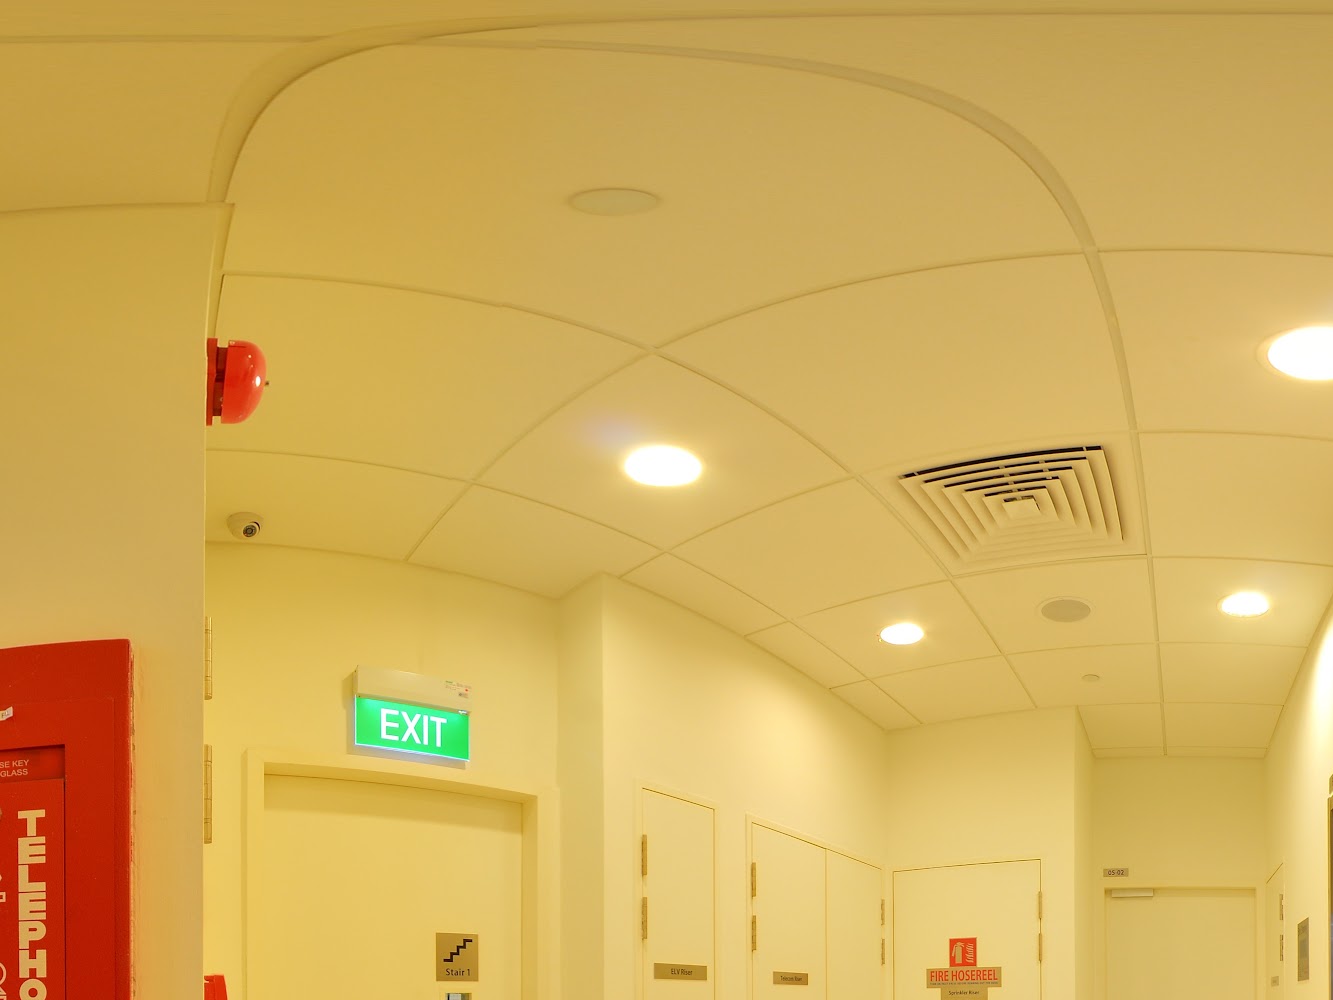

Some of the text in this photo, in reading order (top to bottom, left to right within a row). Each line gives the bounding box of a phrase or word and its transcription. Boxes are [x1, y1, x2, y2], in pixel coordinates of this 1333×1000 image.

[380, 707, 448, 748] EXIT
[12, 759, 30, 767] KEY
[0, 768, 28, 777] GLASS
[445, 967, 471, 976] Stair 1
[681, 968, 693, 976] Riser
[930, 969, 998, 982] FIRE HOSEREEL
